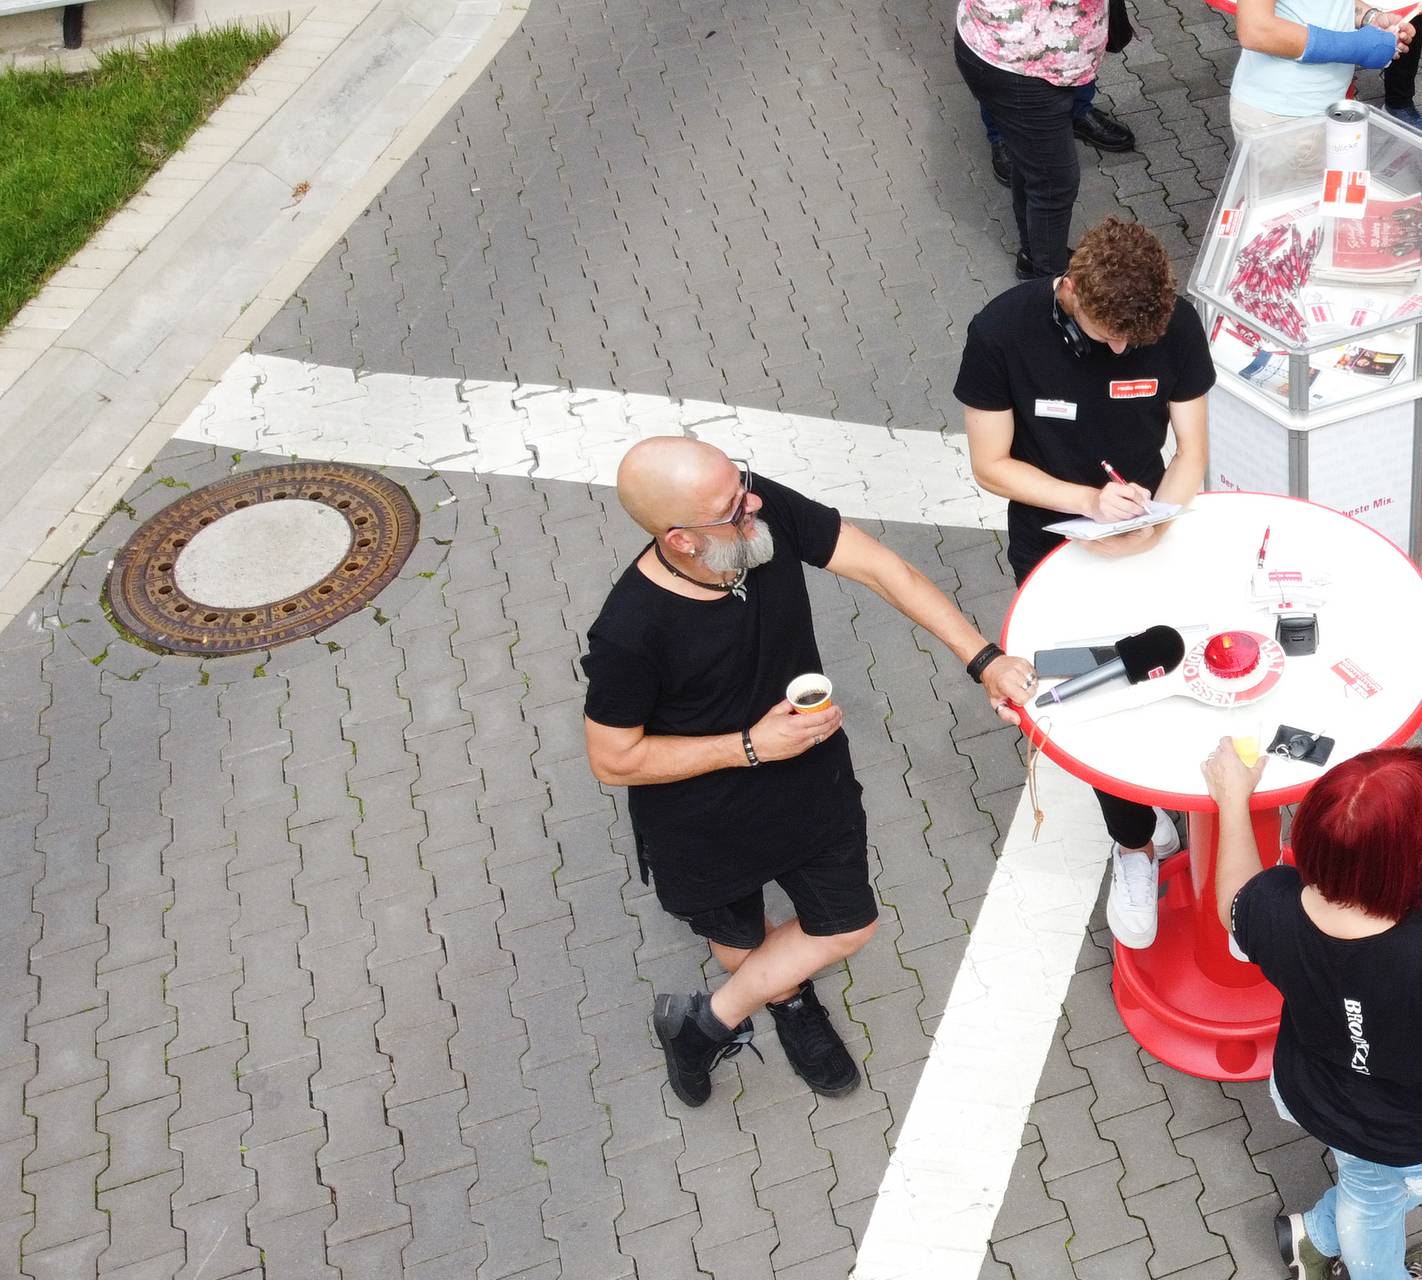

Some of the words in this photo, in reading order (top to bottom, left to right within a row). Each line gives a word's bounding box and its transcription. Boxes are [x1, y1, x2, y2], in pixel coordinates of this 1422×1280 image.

[1373, 496, 1395, 509] Mix.
[1260, 639, 1285, 674] HALT
[1190, 679, 1236, 704] ESSEN
